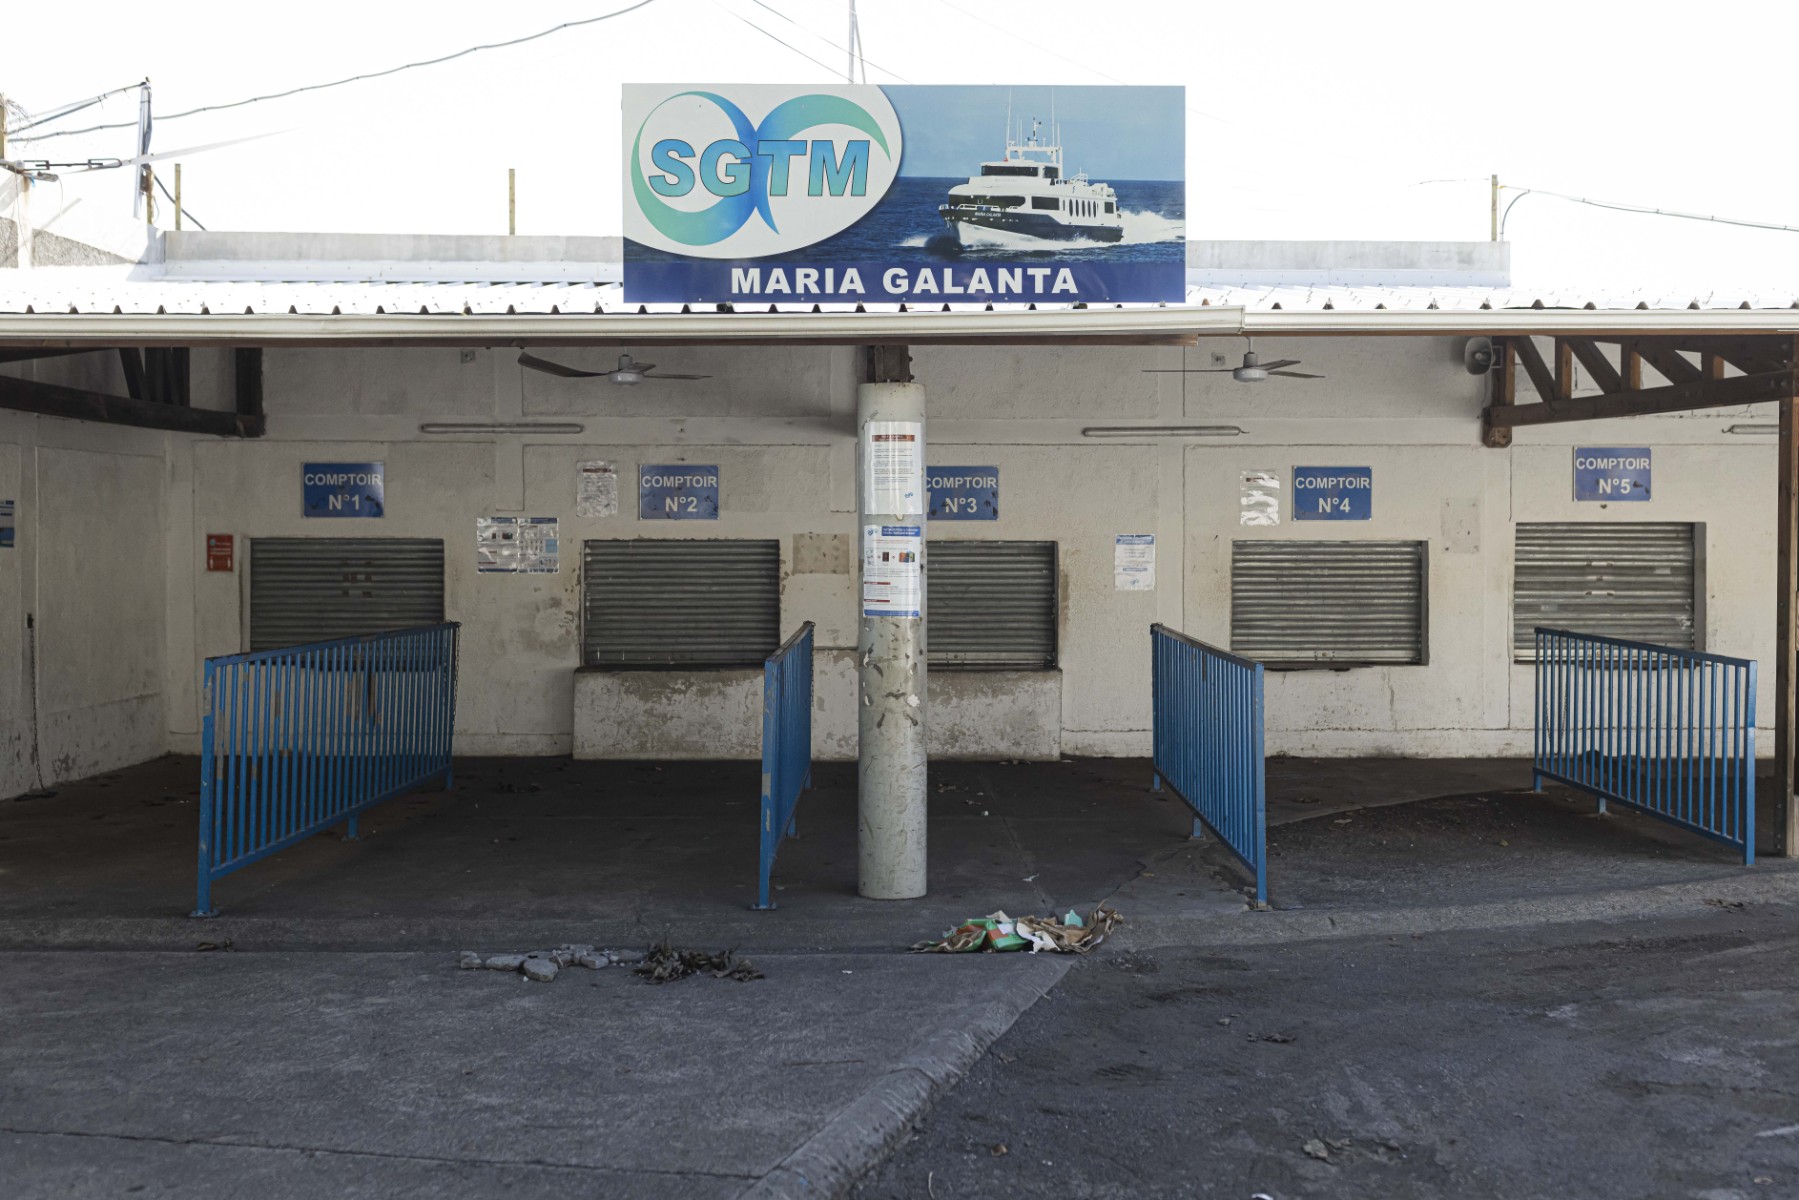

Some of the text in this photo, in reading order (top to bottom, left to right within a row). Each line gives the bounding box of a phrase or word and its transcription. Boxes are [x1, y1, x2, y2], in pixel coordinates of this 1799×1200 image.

[648, 138, 870, 197] SGTM
[731, 267, 1079, 295] MARIA GALANTA
[1576, 457, 1650, 470] COMPTOIR
[304, 473, 382, 486] COMPTOIR
[641, 475, 718, 488] COMPTOIR
[1295, 477, 1370, 489] COMPTOIR
[1598, 478, 1631, 494] N°5
[328, 494, 360, 511] N°1
[665, 496, 698, 512] N°2
[945, 497, 978, 513] N°3
[1318, 497, 1351, 513] N°4
